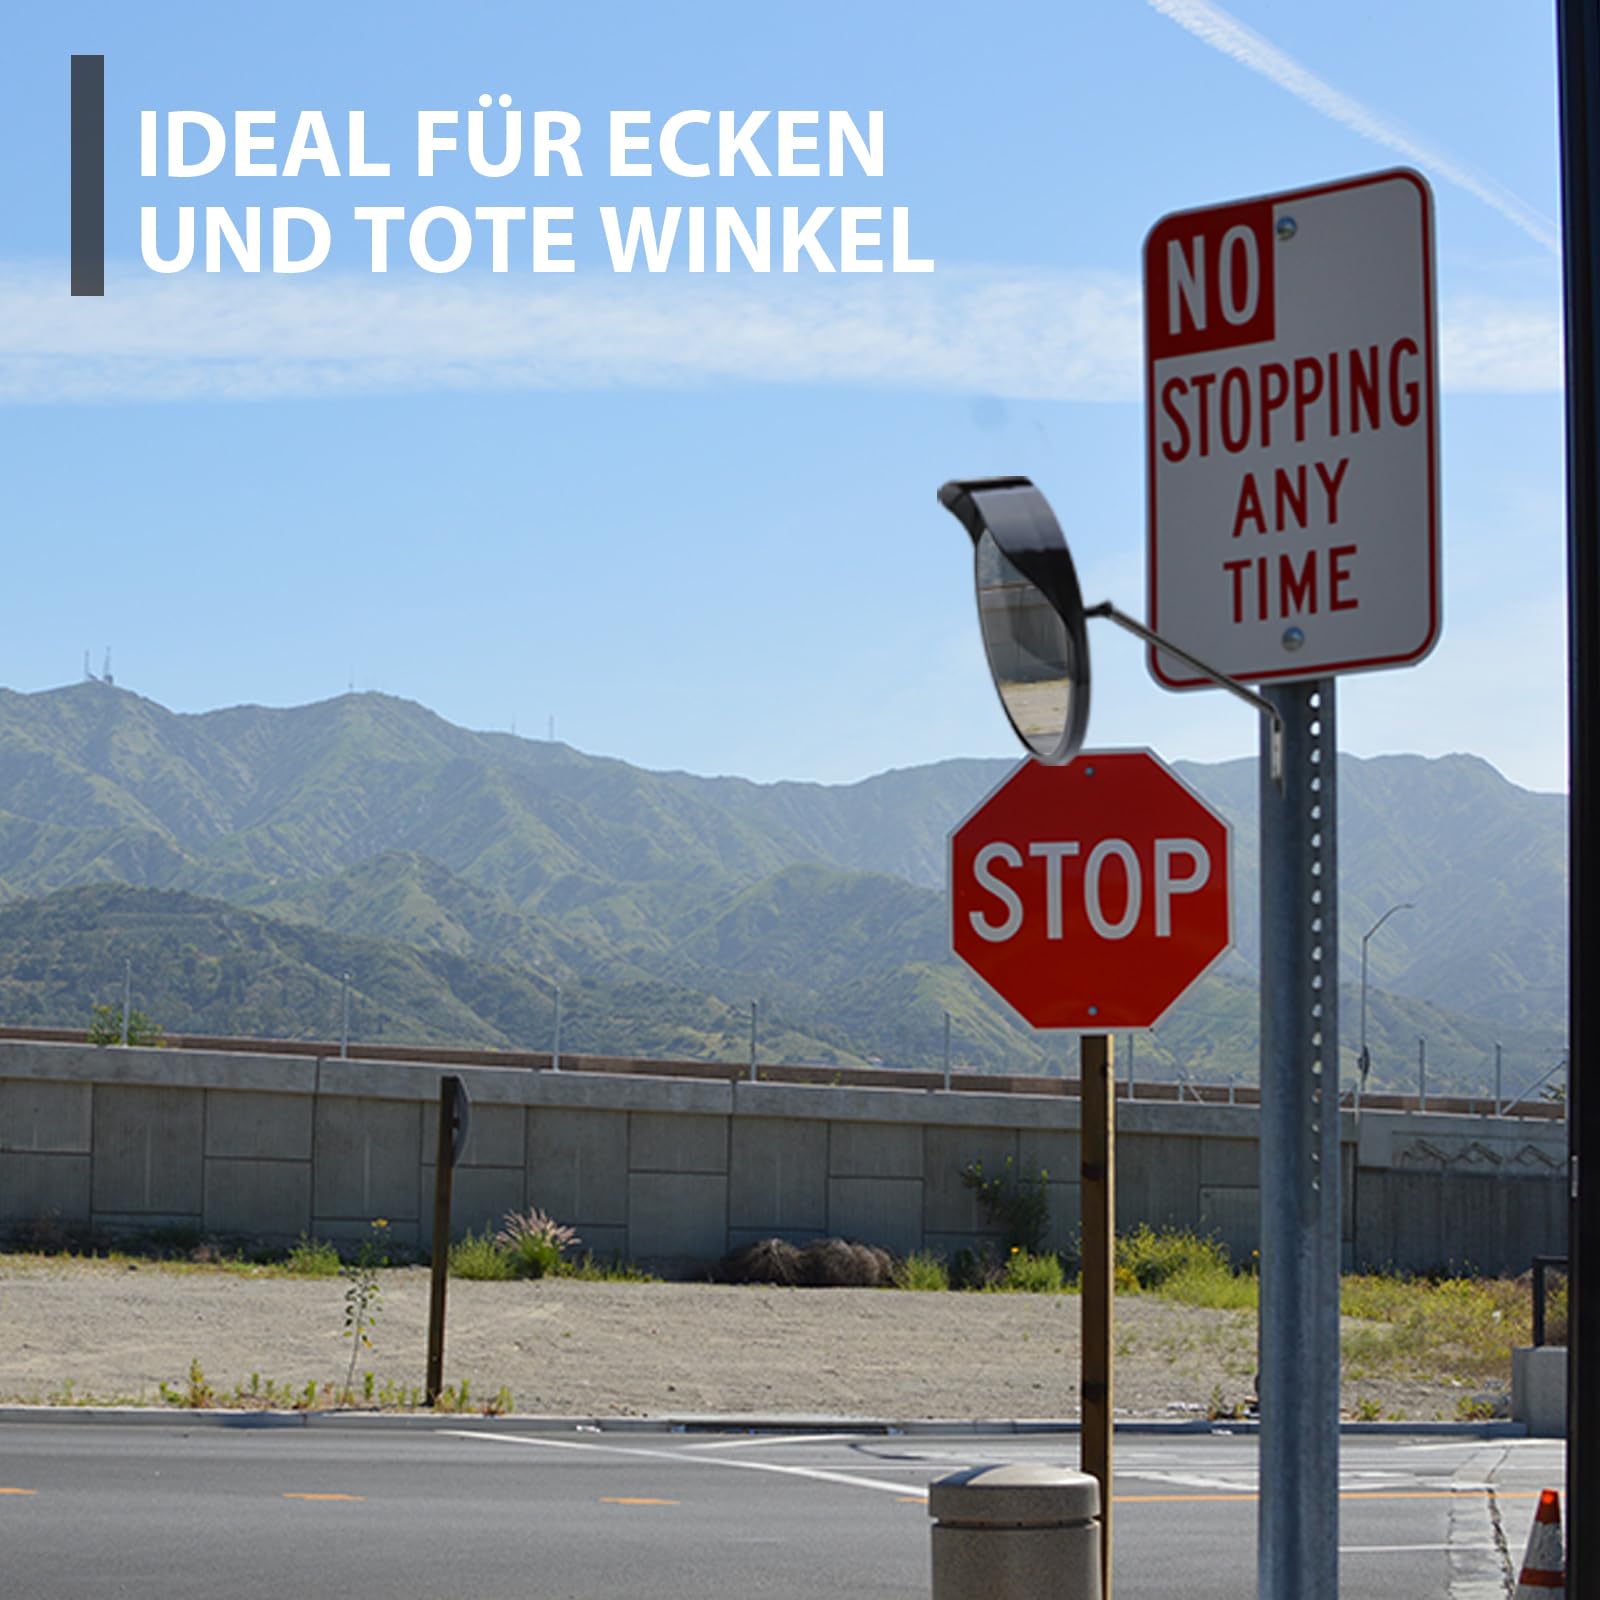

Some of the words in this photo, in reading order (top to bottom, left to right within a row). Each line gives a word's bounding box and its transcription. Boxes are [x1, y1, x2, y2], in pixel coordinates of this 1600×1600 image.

[1167, 225, 1259, 334] NO
[1162, 338, 1420, 462] STOPPING
[1233, 459, 1349, 537] ANY
[1224, 544, 1358, 623] TIME
[969, 838, 1211, 942] STOP
